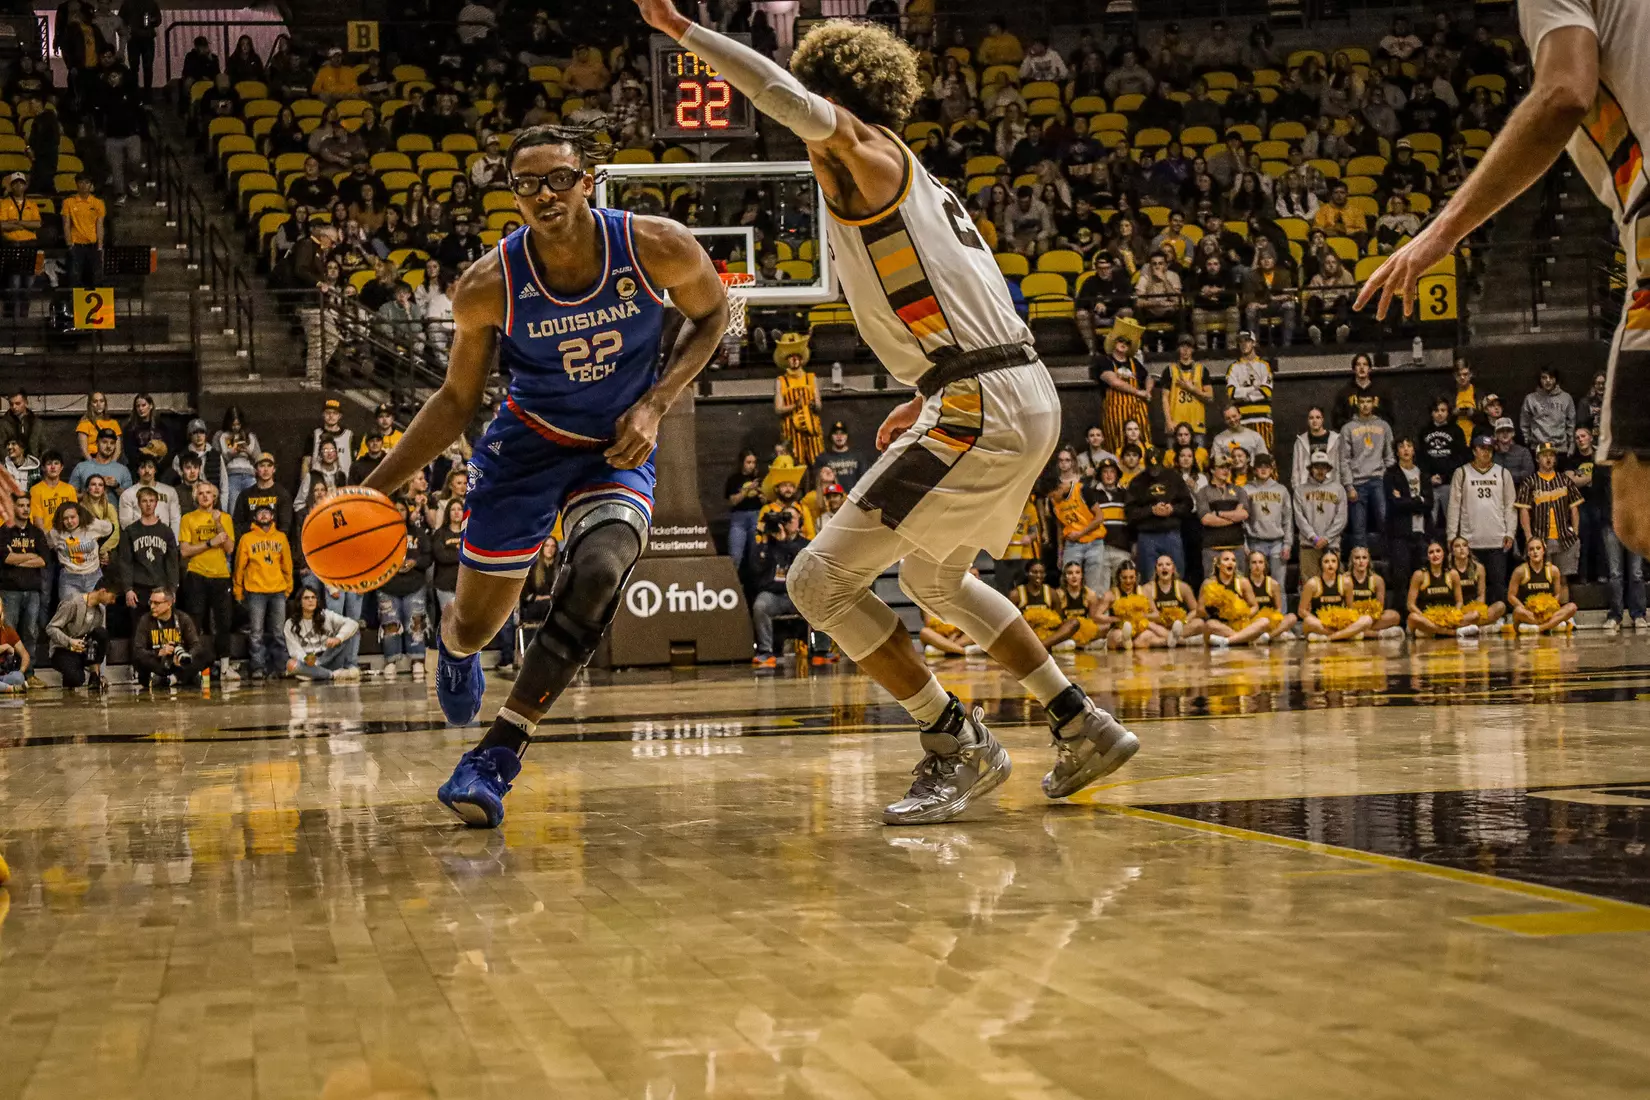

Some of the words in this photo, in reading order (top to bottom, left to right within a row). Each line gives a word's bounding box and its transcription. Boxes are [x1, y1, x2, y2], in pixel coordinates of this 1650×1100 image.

[356, 24, 371, 48] B
[677, 82, 730, 128] 22
[85, 292, 104, 325] 2
[1429, 284, 1448, 316] 3
[526, 300, 641, 339] LOUISIANA
[557, 329, 624, 375] 22
[568, 361, 617, 383] TECH
[1477, 487, 1491, 499] 33
[133, 535, 167, 555] WYOMING
[251, 540, 283, 554] WYOMING
[665, 581, 739, 612] fnbo
